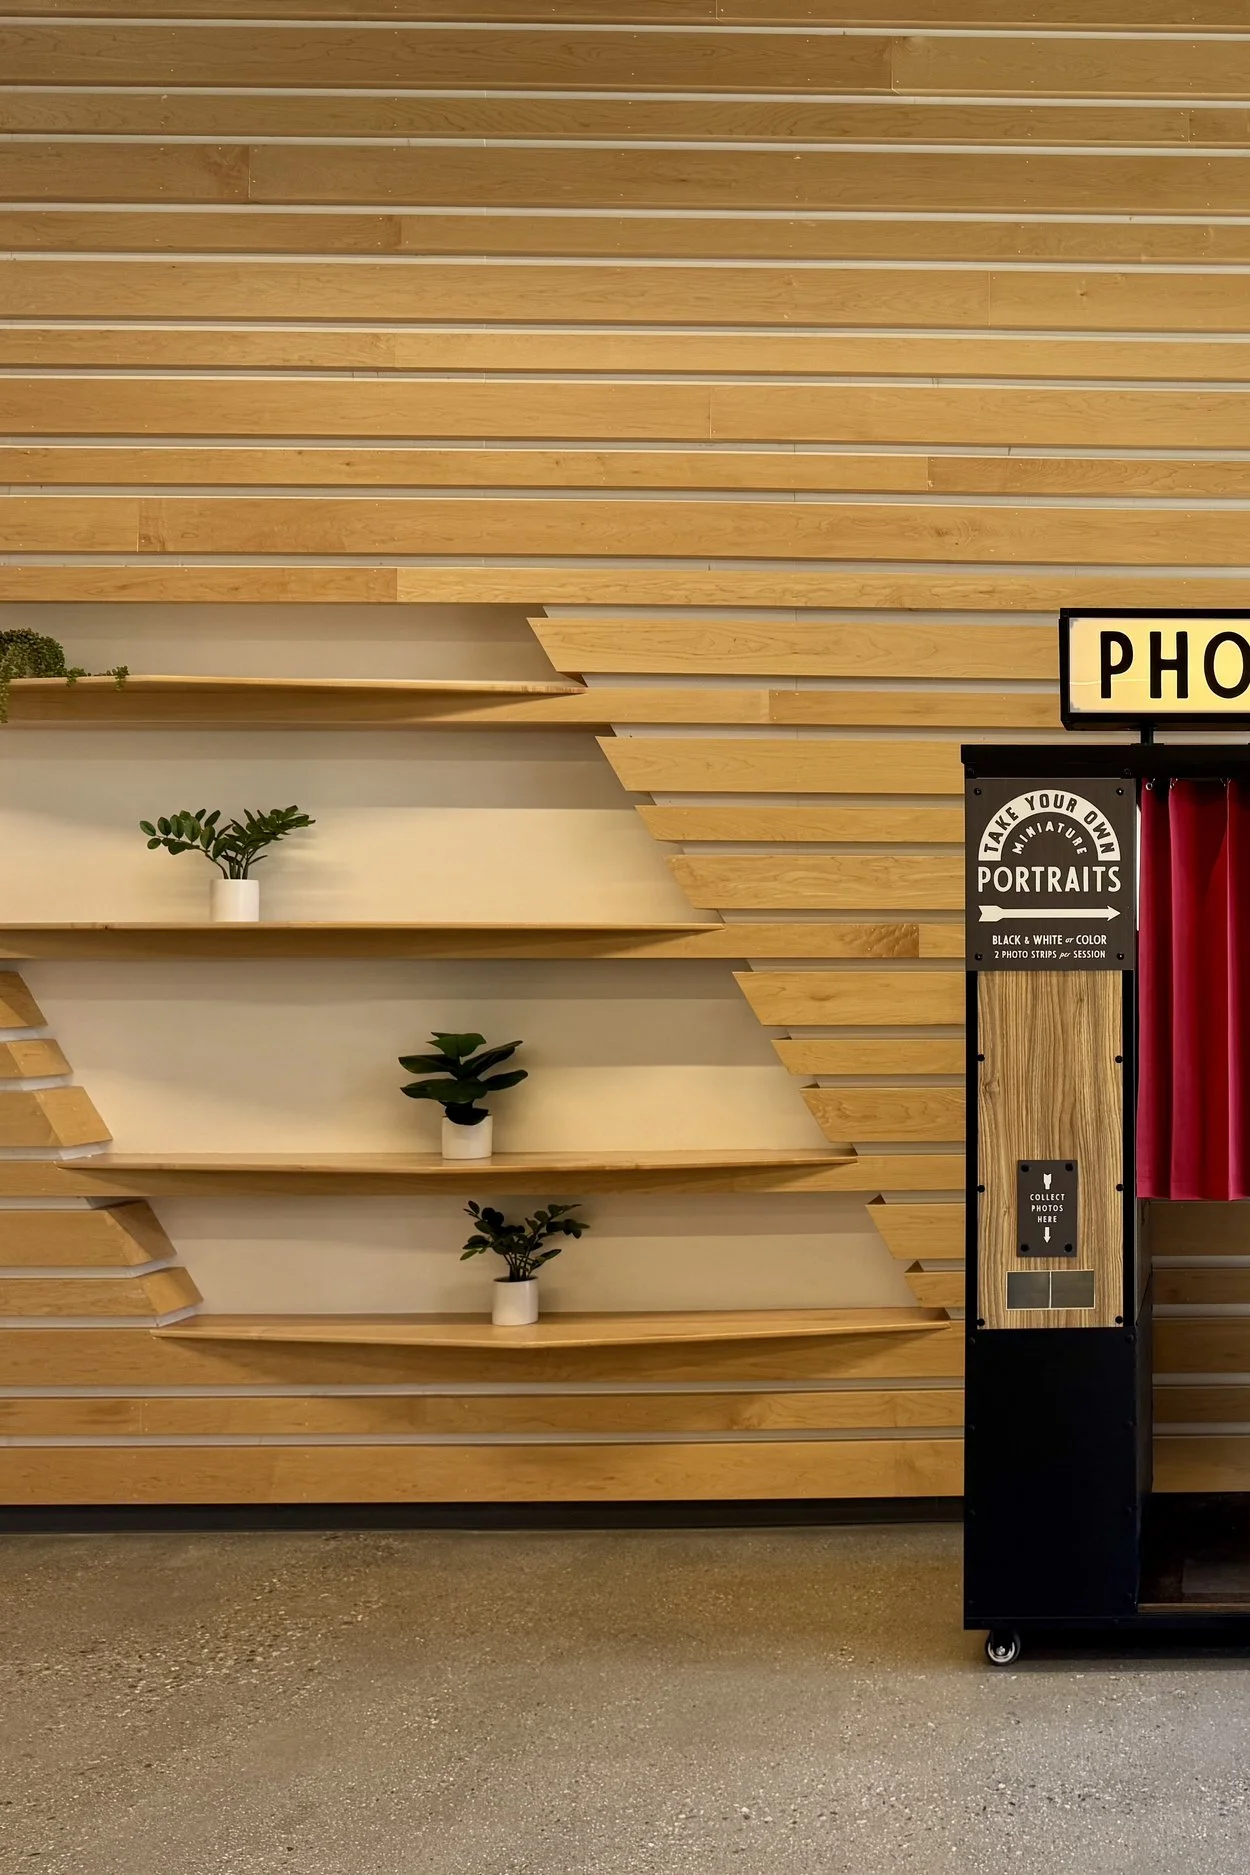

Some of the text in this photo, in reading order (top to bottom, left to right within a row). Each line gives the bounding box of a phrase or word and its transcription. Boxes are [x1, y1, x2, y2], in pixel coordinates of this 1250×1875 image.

[984, 793, 1116, 855] TAKE YOUR OWN
[1011, 820, 1088, 855] MINIATURE
[977, 866, 1122, 893] PORTRAITS
[992, 934, 1021, 945] BLACK
[1024, 936, 1030, 945] &
[1032, 934, 1063, 945] WHITE
[1075, 934, 1107, 945] COLOR
[994, 950, 1106, 960] 2 PHOTO STRIPS per SESSION
[1029, 1193, 1065, 1201] COLLECT
[1031, 1204, 1064, 1212] PHOTOS
[1037, 1215, 1057, 1223] HERE
